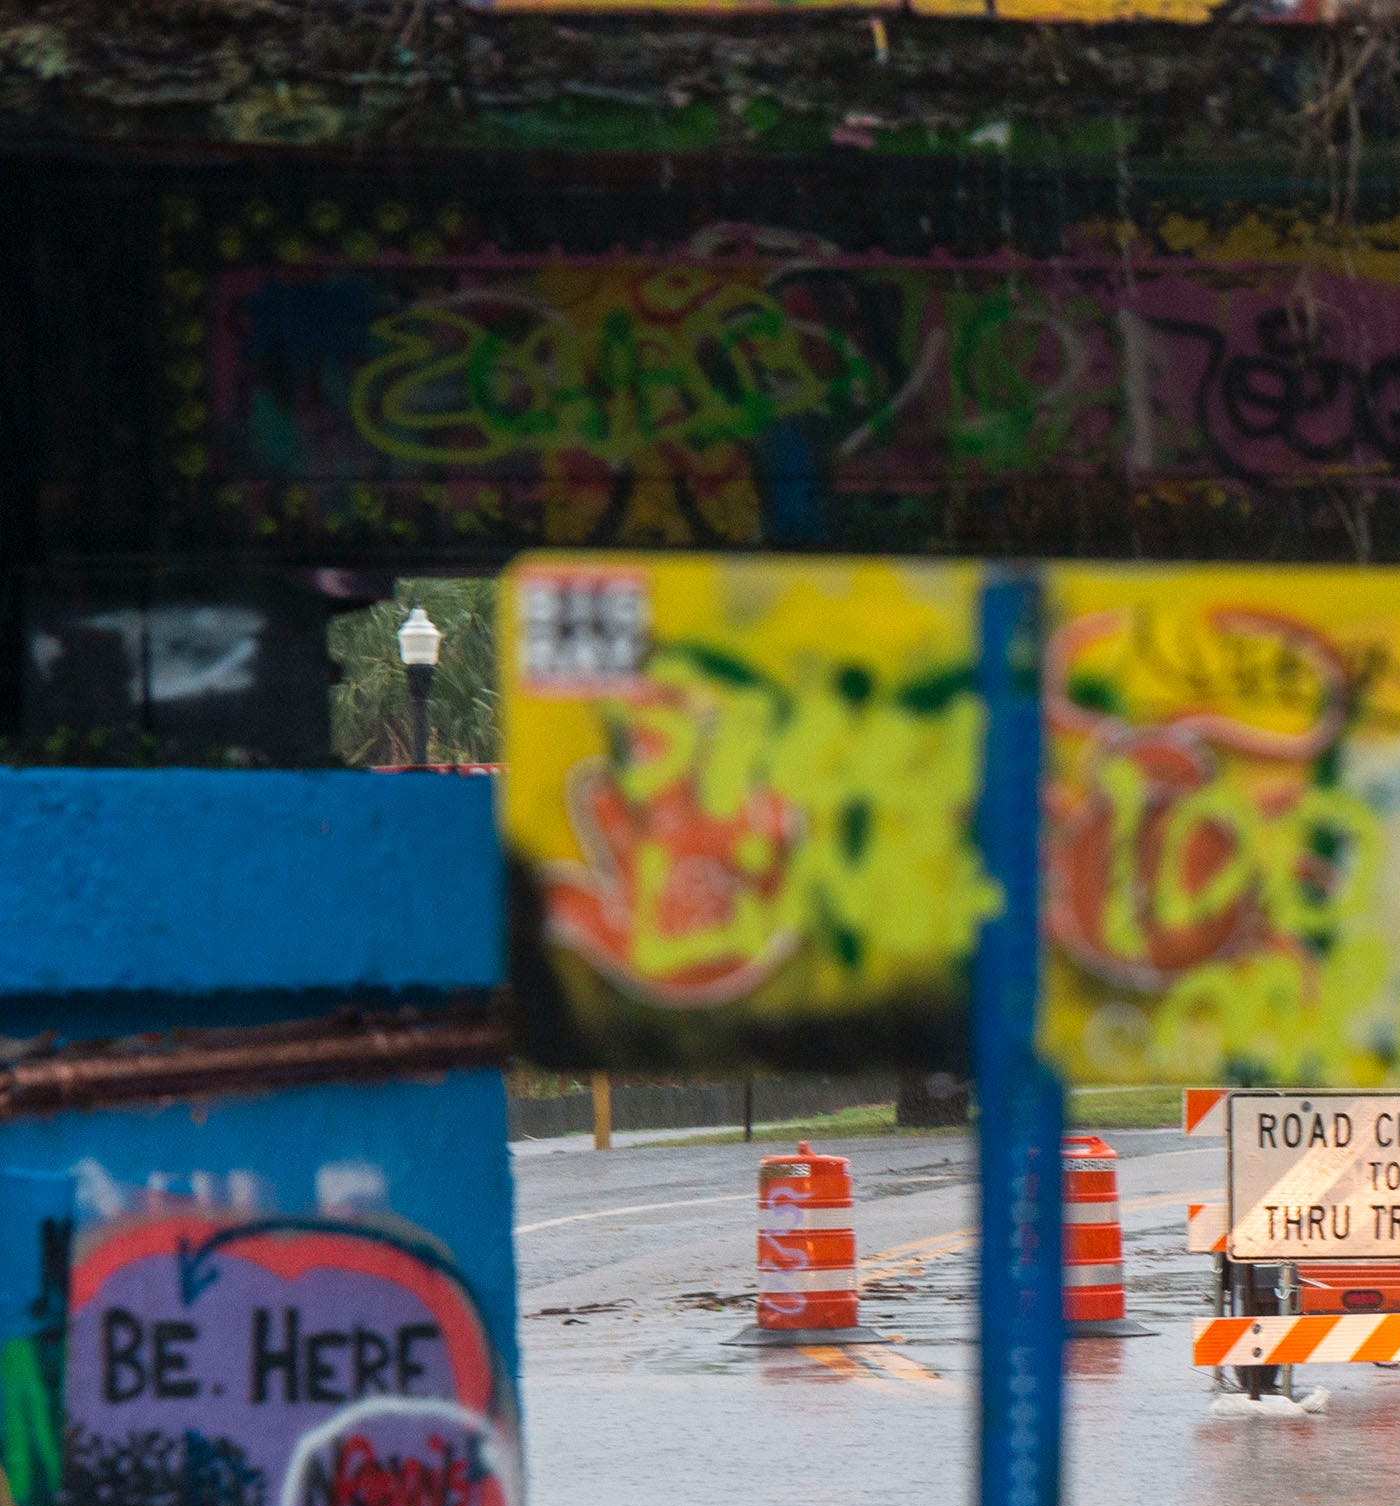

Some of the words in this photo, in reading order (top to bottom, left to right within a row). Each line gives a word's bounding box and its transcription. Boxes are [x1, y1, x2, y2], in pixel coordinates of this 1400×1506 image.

[1258, 1111, 1353, 1148] ROAD
[1265, 1204, 1351, 1241] THRU
[249, 1306, 442, 1405] HERE
